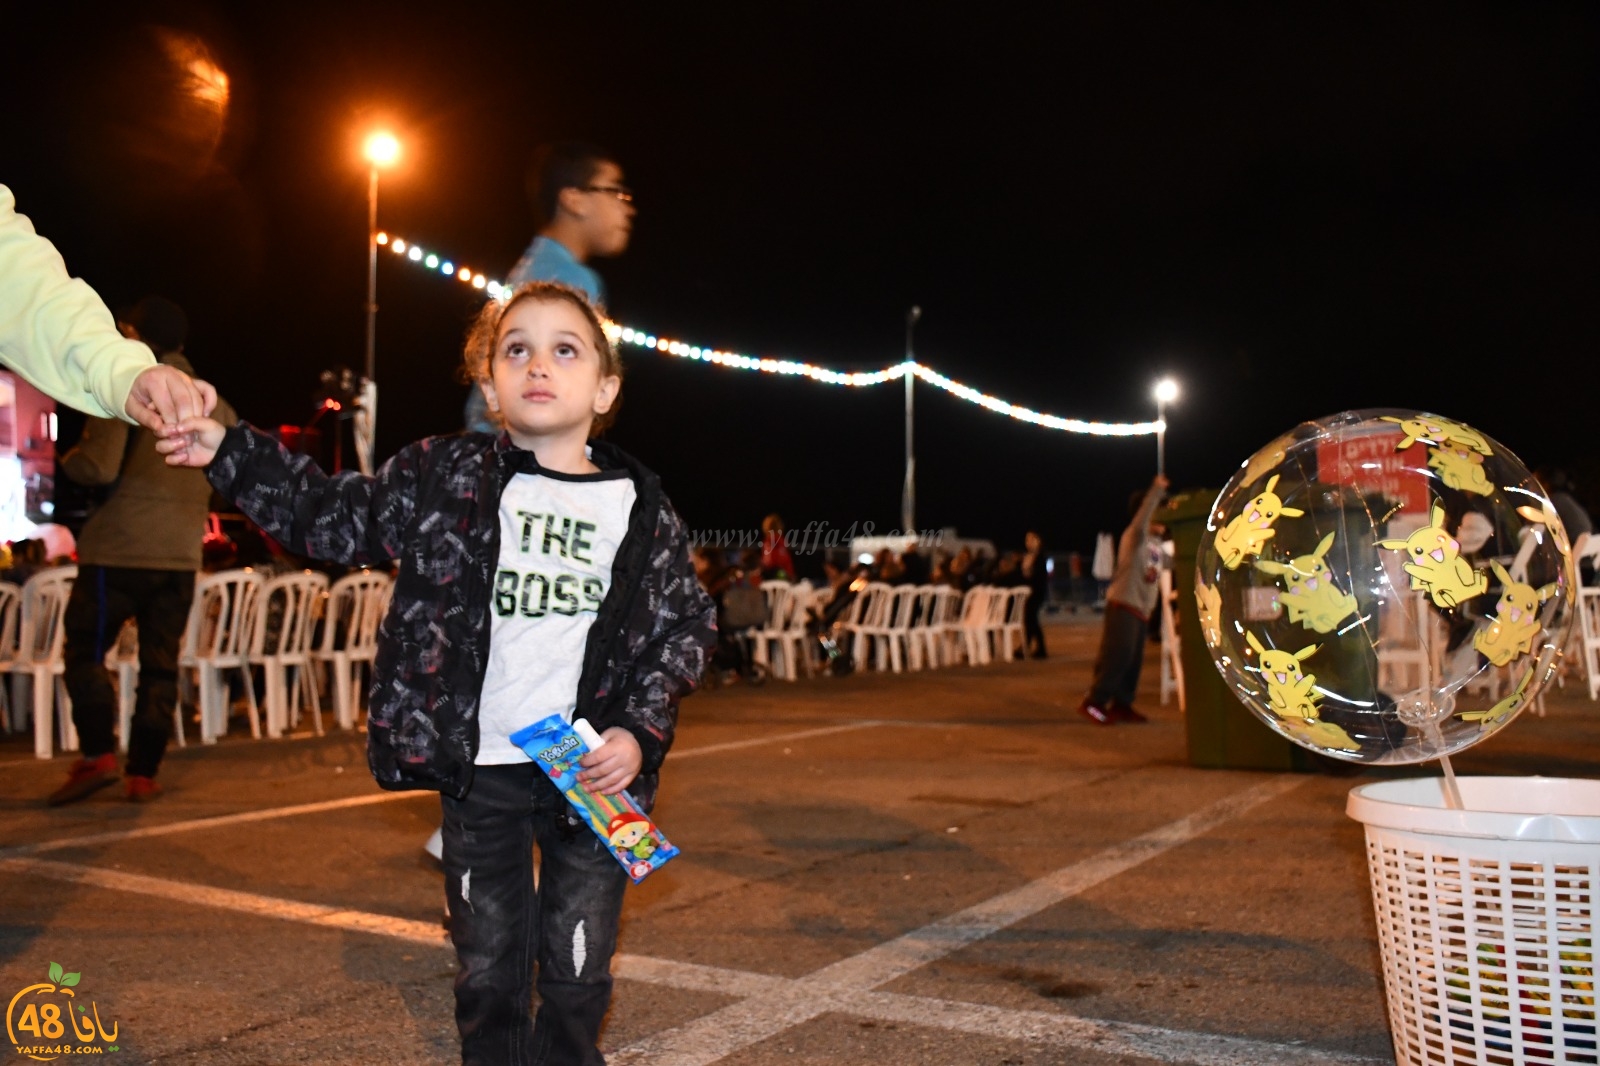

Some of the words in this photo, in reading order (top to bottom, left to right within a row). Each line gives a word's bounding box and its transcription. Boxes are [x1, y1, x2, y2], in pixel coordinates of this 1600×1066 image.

[517, 510, 597, 565] THE
[495, 570, 604, 618] BOSS
[540, 736, 579, 762] Yoguata
